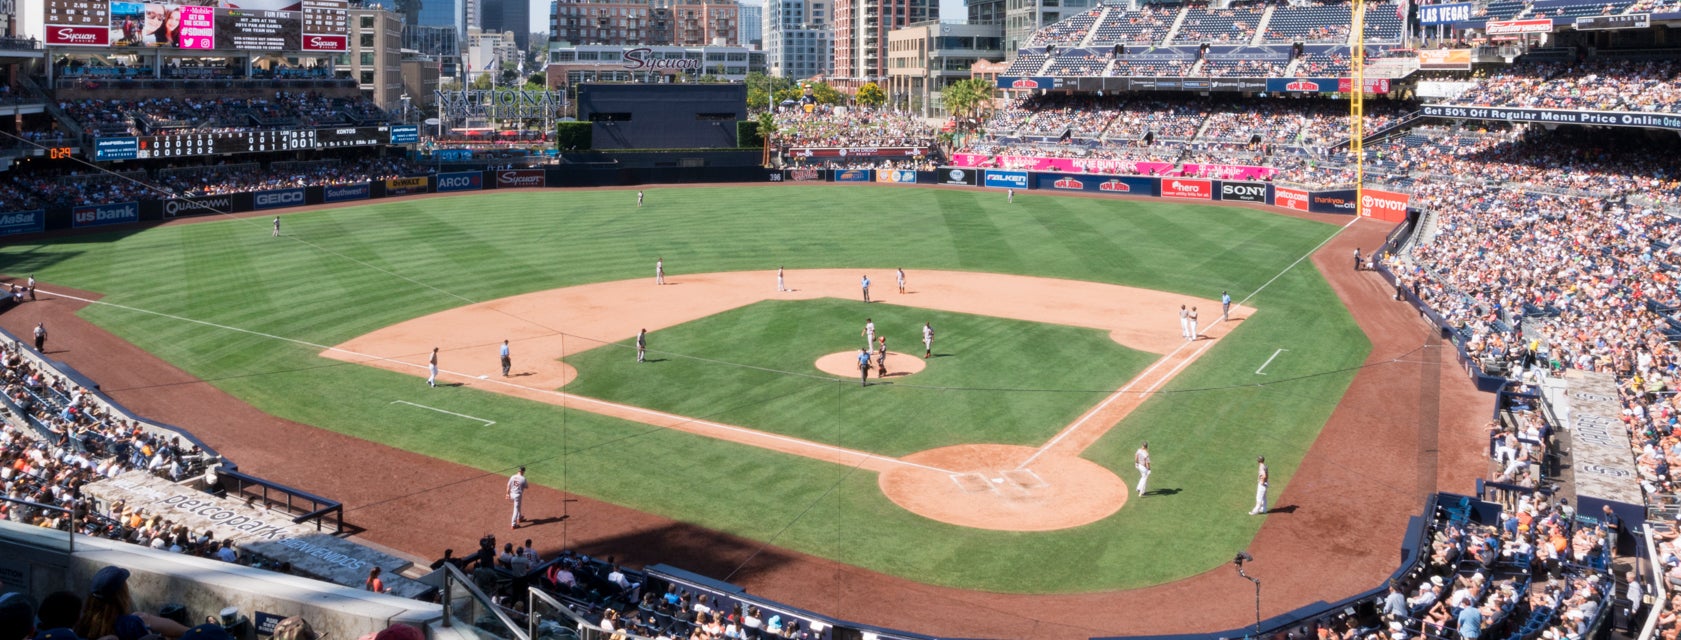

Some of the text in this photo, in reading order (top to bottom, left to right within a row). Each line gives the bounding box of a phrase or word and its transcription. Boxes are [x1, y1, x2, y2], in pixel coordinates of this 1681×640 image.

[1421, 6, 1469, 22] LAS VEGAS
[58, 28, 97, 42] Sycuan
[310, 37, 338, 48] Sycuan
[623, 48, 701, 76] Sycuan
[434, 90, 570, 106] NATIONAL
[446, 106, 558, 118] UNIVERSITY
[1470, 109, 1487, 117] Off
[1491, 110, 1536, 120] Regular
[1541, 112, 1576, 121] Menu
[1581, 114, 1616, 123] Price
[1622, 115, 1661, 125] Online
[292, 138, 313, 148] 0 0 1
[439, 177, 470, 187] ARCO
[499, 172, 541, 185] Sycuan
[1101, 182, 1113, 190] PAPA
[1178, 184, 1199, 192] hero
[1223, 185, 1266, 196] SONY
[257, 192, 303, 205] GEICO
[328, 188, 362, 198] Southwest
[1276, 190, 1308, 200] petco.com
[166, 199, 229, 216] QUALCOMM
[1373, 199, 1407, 211] TOYOTA
[161, 493, 285, 539] petcopark
[277, 537, 365, 570] BIENVENIDOS
